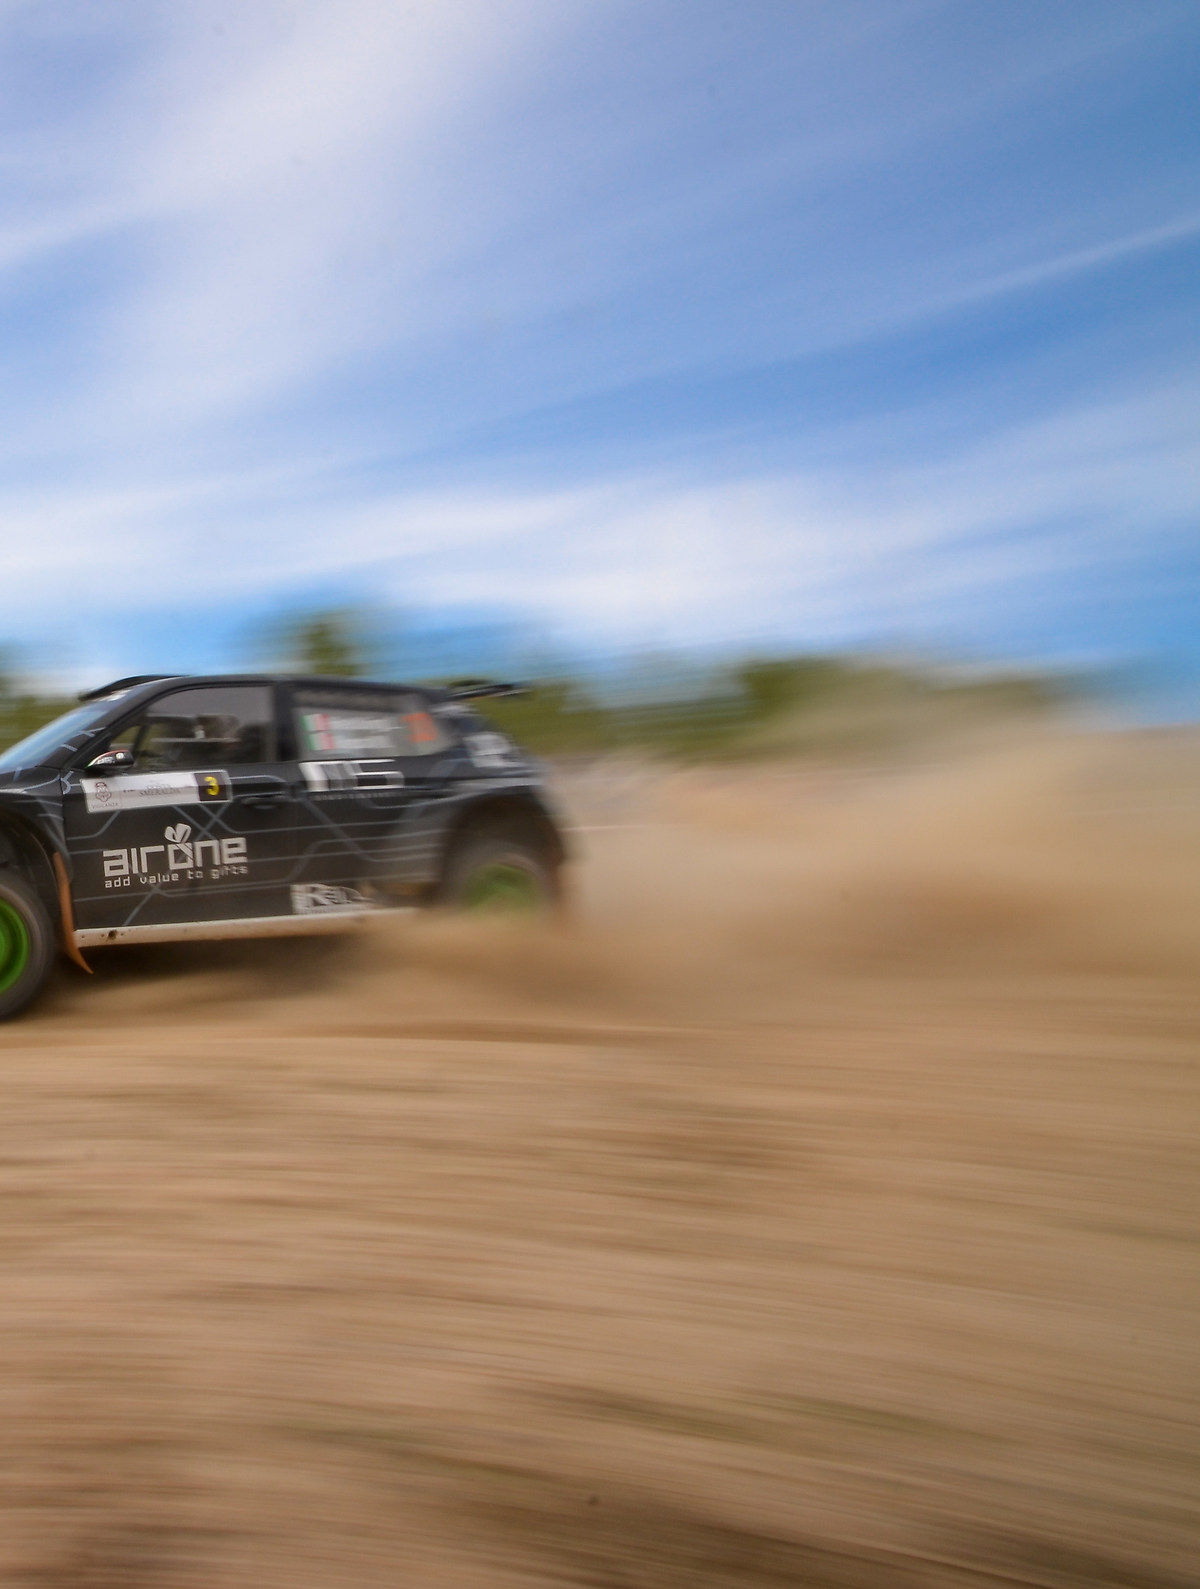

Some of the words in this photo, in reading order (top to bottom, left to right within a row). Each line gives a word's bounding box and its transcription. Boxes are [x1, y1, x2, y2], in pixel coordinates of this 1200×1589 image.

[204, 776, 219, 795] 3
[105, 877, 131, 889] add
[140, 873, 179, 885] value
[187, 870, 203, 879] to
[210, 865, 248, 880] gifts
